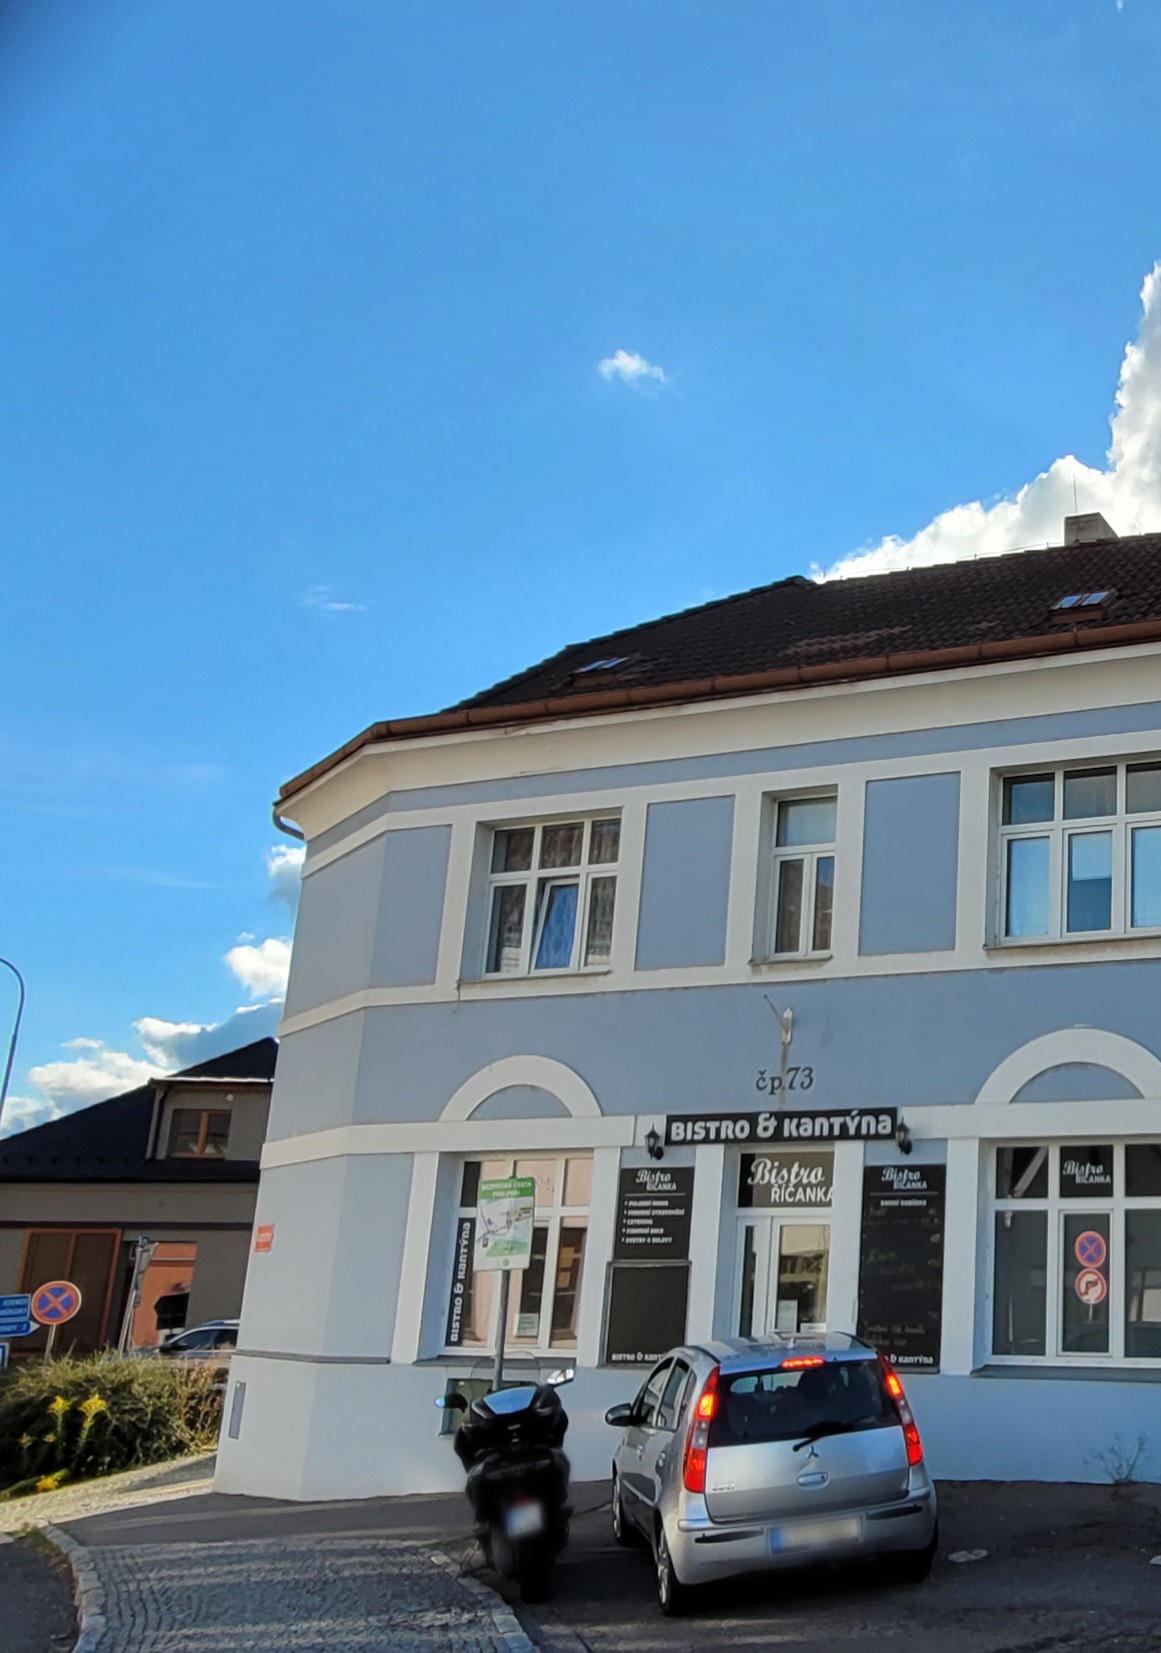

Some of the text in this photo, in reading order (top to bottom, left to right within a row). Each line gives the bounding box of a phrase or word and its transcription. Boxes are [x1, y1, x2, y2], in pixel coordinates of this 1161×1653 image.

[670, 1119, 750, 1141] BISTRO
[756, 1112, 778, 1139] &
[636, 1169, 671, 1185] Bistro
[747, 1158, 825, 1186] Bistro
[881, 1167, 921, 1182] Bistro
[1062, 1160, 1104, 1178] Bistro
[454, 1282, 464, 1294] &
[450, 1297, 463, 1342] BISTRO
